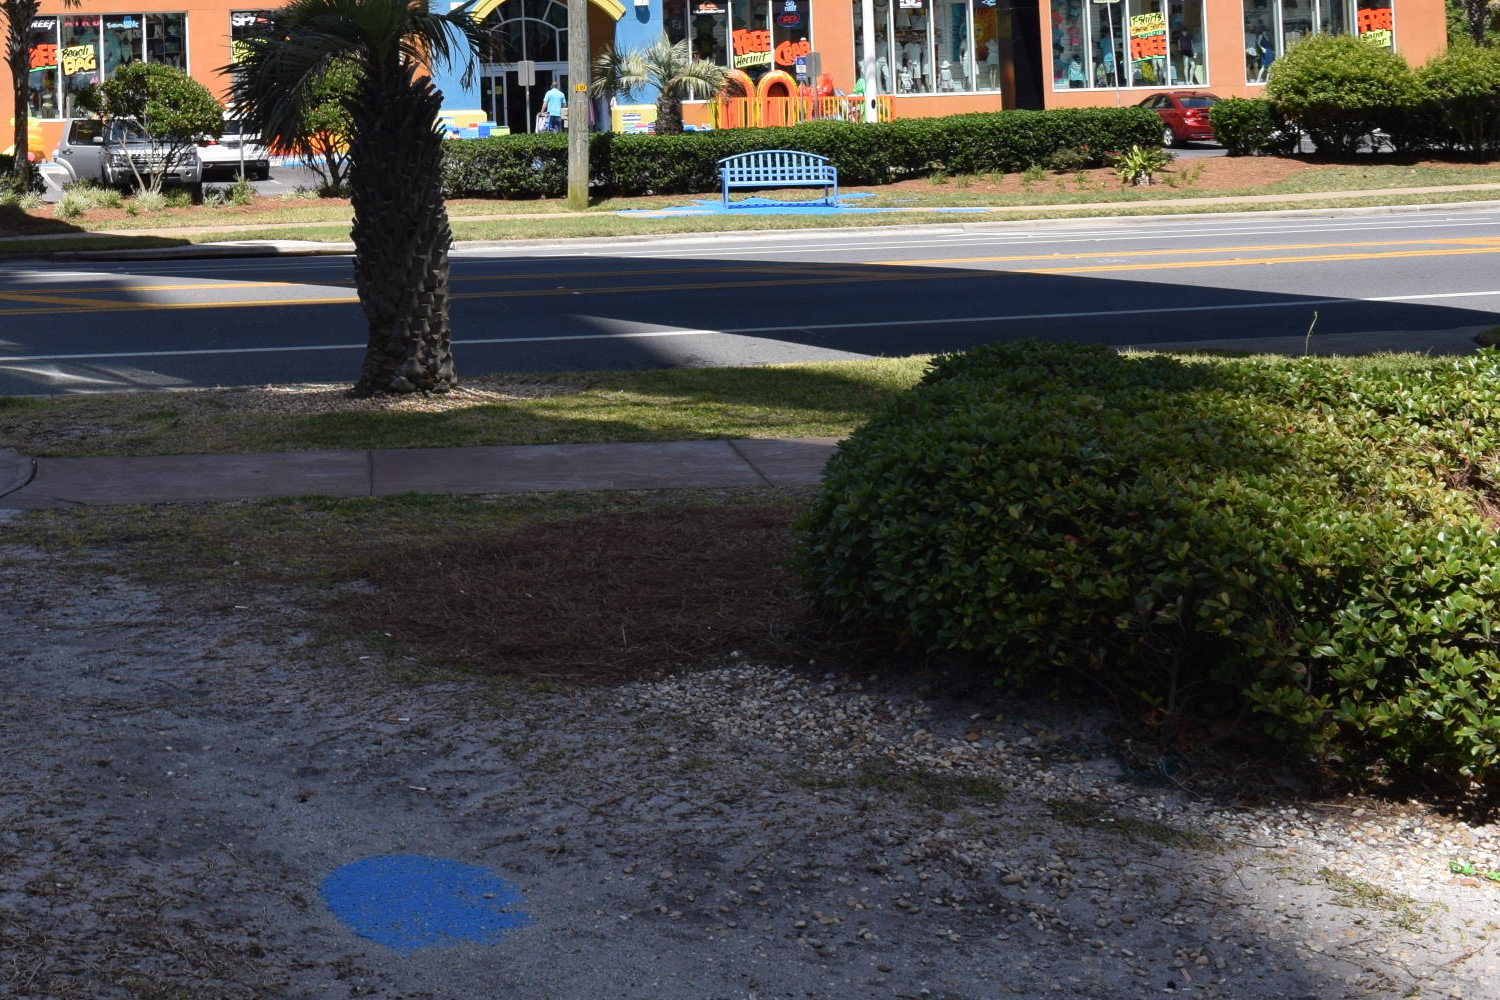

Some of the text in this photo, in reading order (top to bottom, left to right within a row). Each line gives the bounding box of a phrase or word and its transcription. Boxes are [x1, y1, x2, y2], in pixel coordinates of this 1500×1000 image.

[30, 19, 56, 30] REEF
[731, 28, 771, 55] FREE
[1131, 35, 1167, 60] FREE
[63, 55, 97, 76] BAG
[736, 53, 768, 66] Hermit
